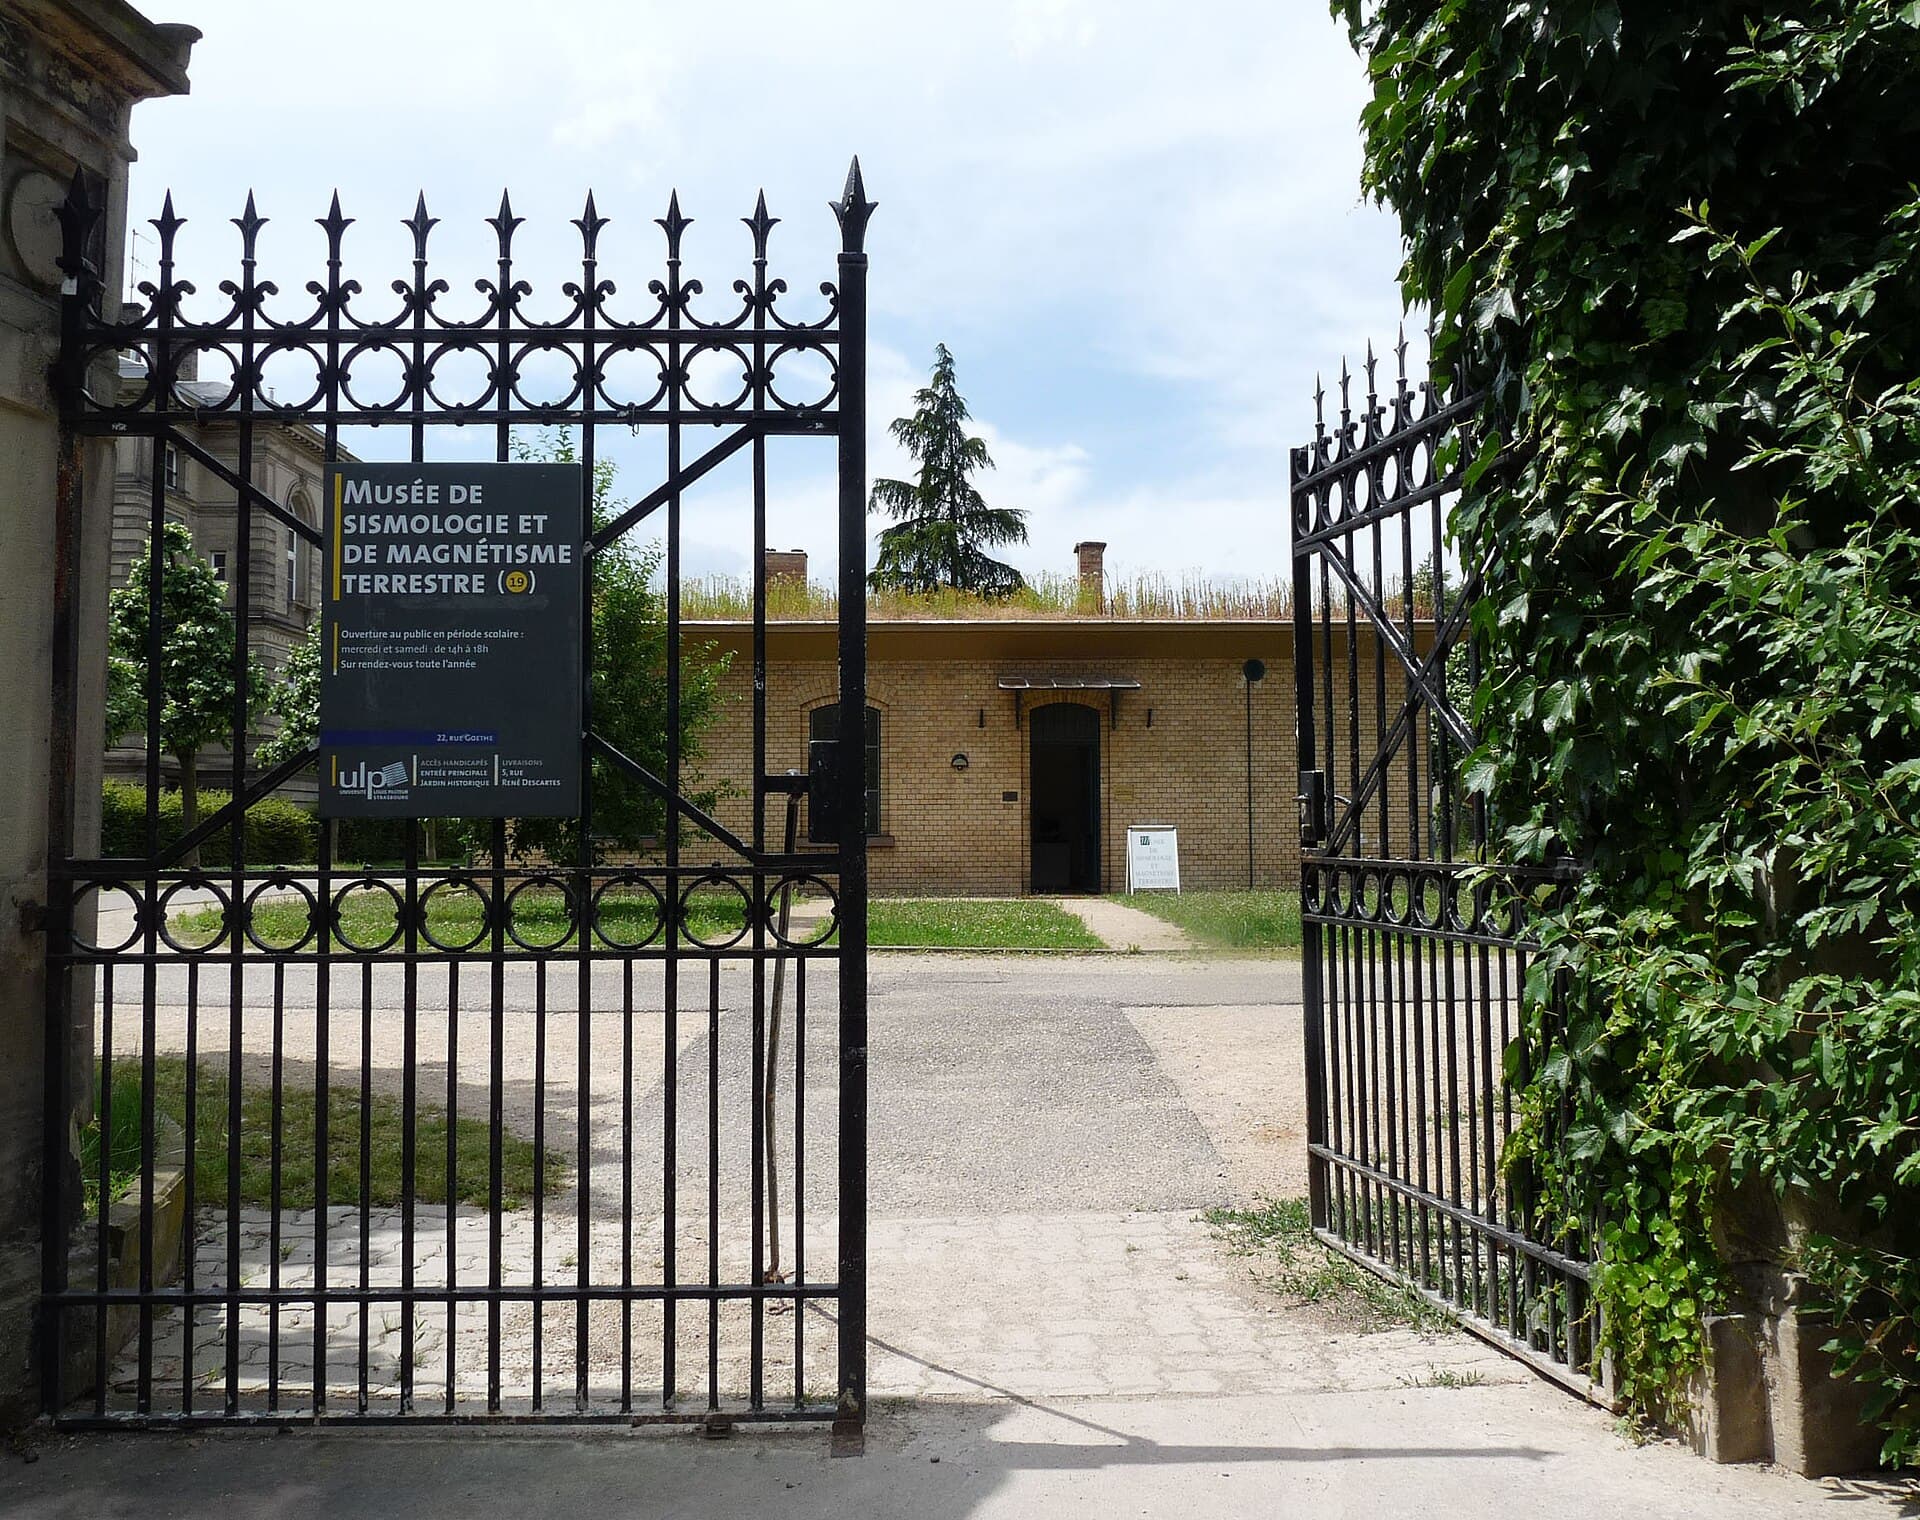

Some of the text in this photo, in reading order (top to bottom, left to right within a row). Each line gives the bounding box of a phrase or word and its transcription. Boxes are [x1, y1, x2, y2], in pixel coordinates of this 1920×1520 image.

[343, 478, 483, 505] MUSÉE DE
[343, 514, 549, 535] SISMOLOGIE ET
[343, 537, 572, 564] DE MAGNÉTISME
[342, 574, 486, 594] TERRESTRE
[341, 630, 390, 639] Ouverture
[390, 631, 402, 639] au
[403, 629, 432, 641] public
[433, 631, 445, 639] en
[447, 629, 482, 641] période
[483, 629, 520, 639] scolaire
[341, 644, 381, 654] mercredi
[383, 645, 393, 654] et
[394, 644, 428, 654] samedi
[434, 644, 446, 654] de
[447, 644, 464, 655] 14h
[465, 644, 471, 654] à
[472, 644, 489, 654] 18h
[340, 659, 477, 669] Sur rendez-vous toute l'année
[437, 734, 449, 743] 22,
[339, 761, 387, 800] ulp
